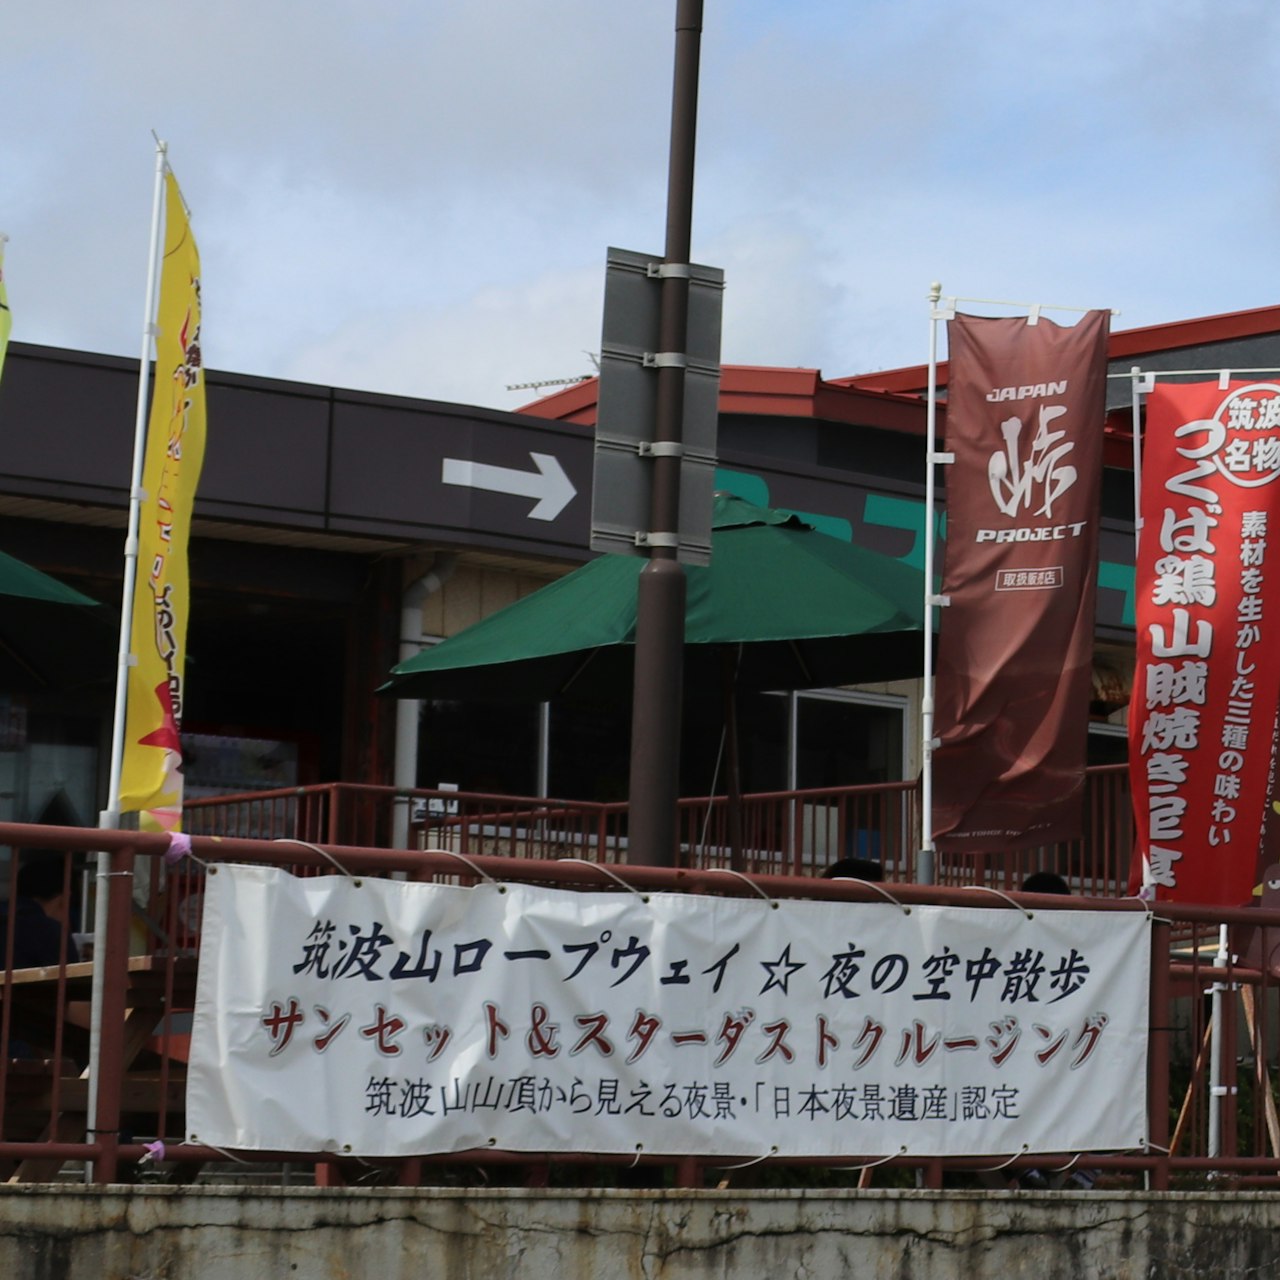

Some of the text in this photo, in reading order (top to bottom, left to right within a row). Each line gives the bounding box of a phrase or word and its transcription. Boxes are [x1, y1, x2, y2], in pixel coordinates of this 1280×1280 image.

[986, 380, 1068, 402] JAPAN
[976, 521, 1088, 543] PROJECT
[1003, 571, 1056, 587] 取扱販売店
[1208, 511, 1267, 847] 素材を生かした三種の味わい
